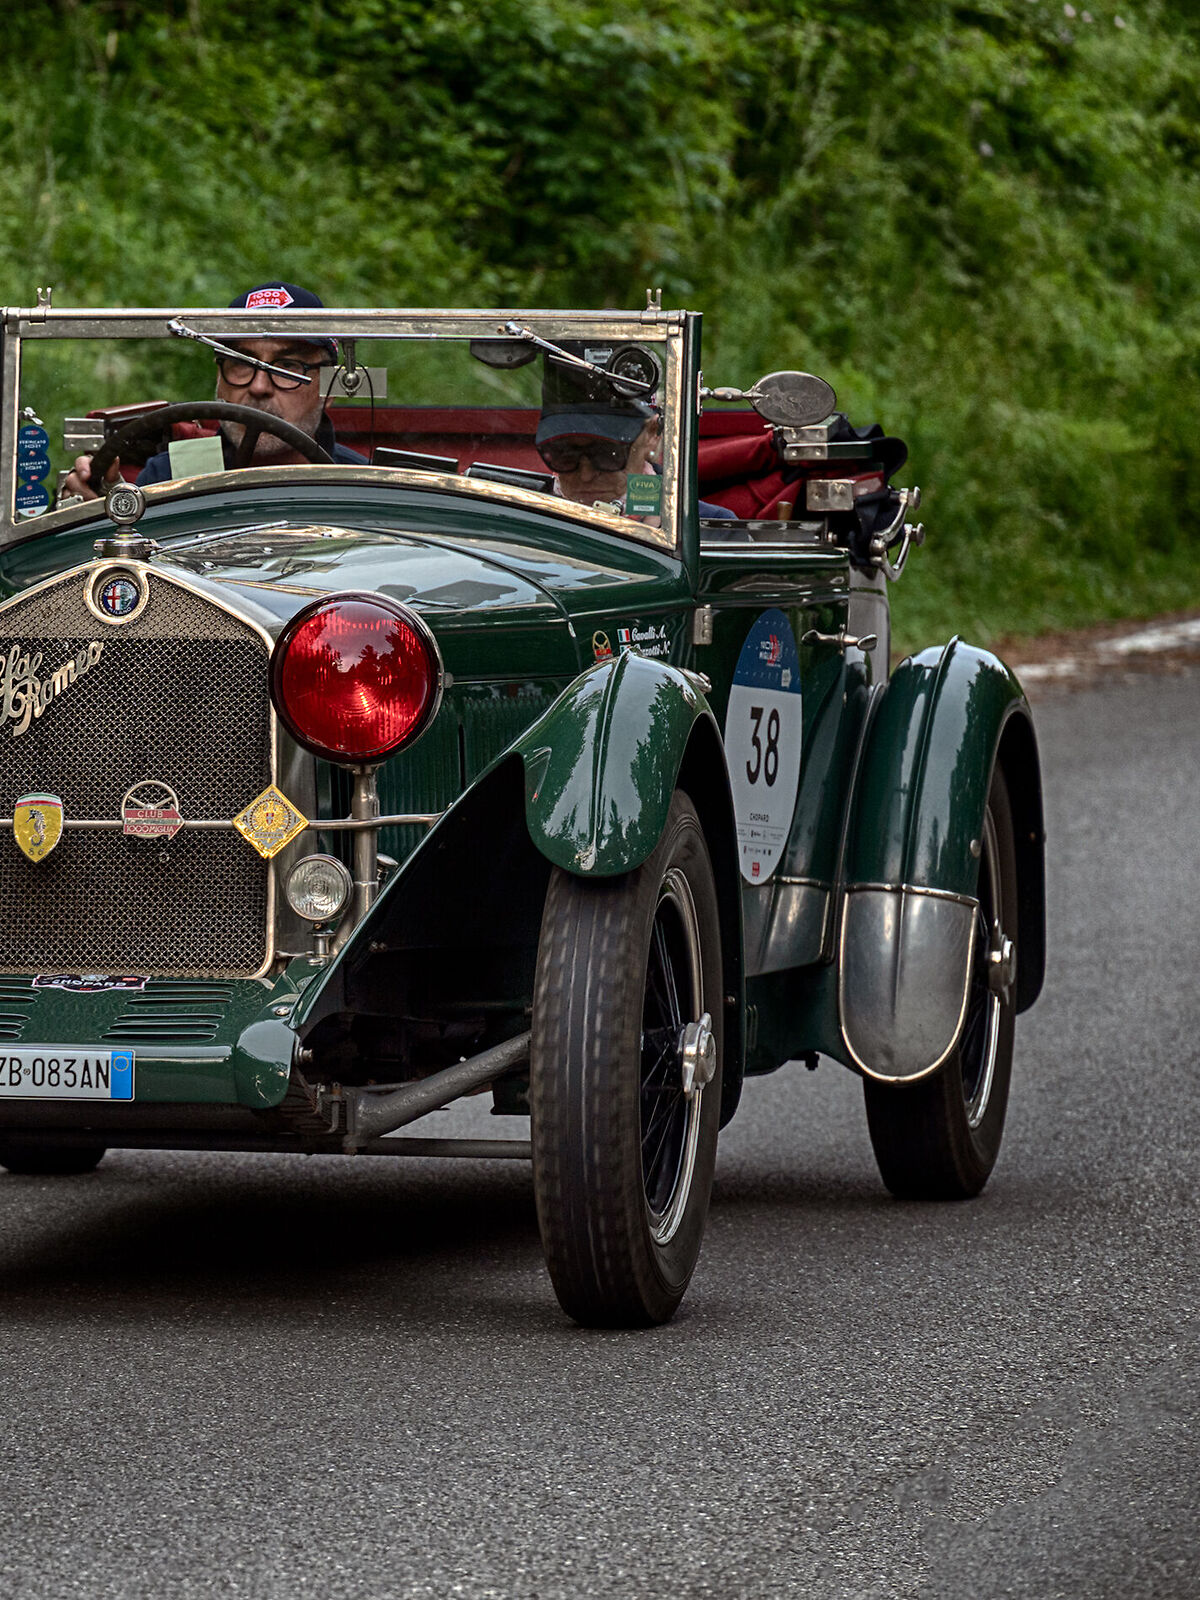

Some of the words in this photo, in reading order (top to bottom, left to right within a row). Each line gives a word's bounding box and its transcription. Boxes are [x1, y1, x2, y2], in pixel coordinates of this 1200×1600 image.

[252, 291, 280, 299] 1000
[250, 298, 281, 306] MIGLIA
[9, 641, 104, 737] Romeo
[746, 706, 780, 788] 38
[137, 810, 164, 818] CLUB
[750, 812, 769, 822] CHOPARD
[51, 979, 127, 988] CHOPARD
